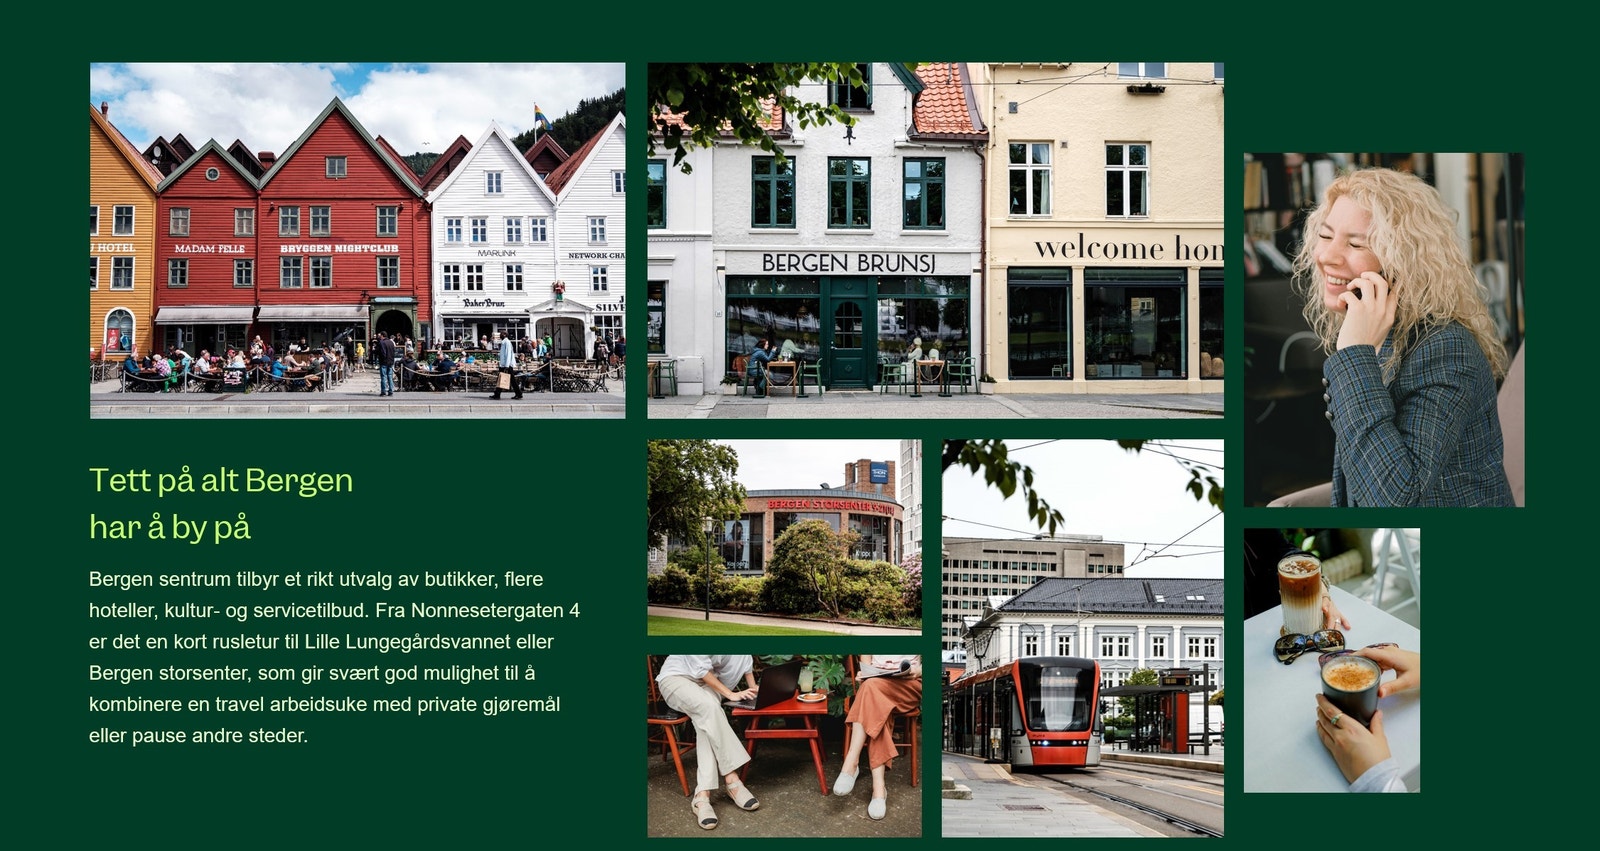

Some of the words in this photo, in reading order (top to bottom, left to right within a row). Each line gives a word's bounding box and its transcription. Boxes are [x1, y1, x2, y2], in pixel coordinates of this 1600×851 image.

[98, 243, 136, 252] HOTEL
[175, 244, 215, 253] MADAM
[280, 244, 331, 253] BRYGGEN
[335, 244, 399, 253] NIGHTCLUB
[1034, 232, 1164, 260] welcome
[763, 253, 848, 272] BERGEN
[858, 253, 936, 274] BRUNSJ
[768, 499, 811, 509] BERGEN
[813, 499, 870, 511] STORSENTER
